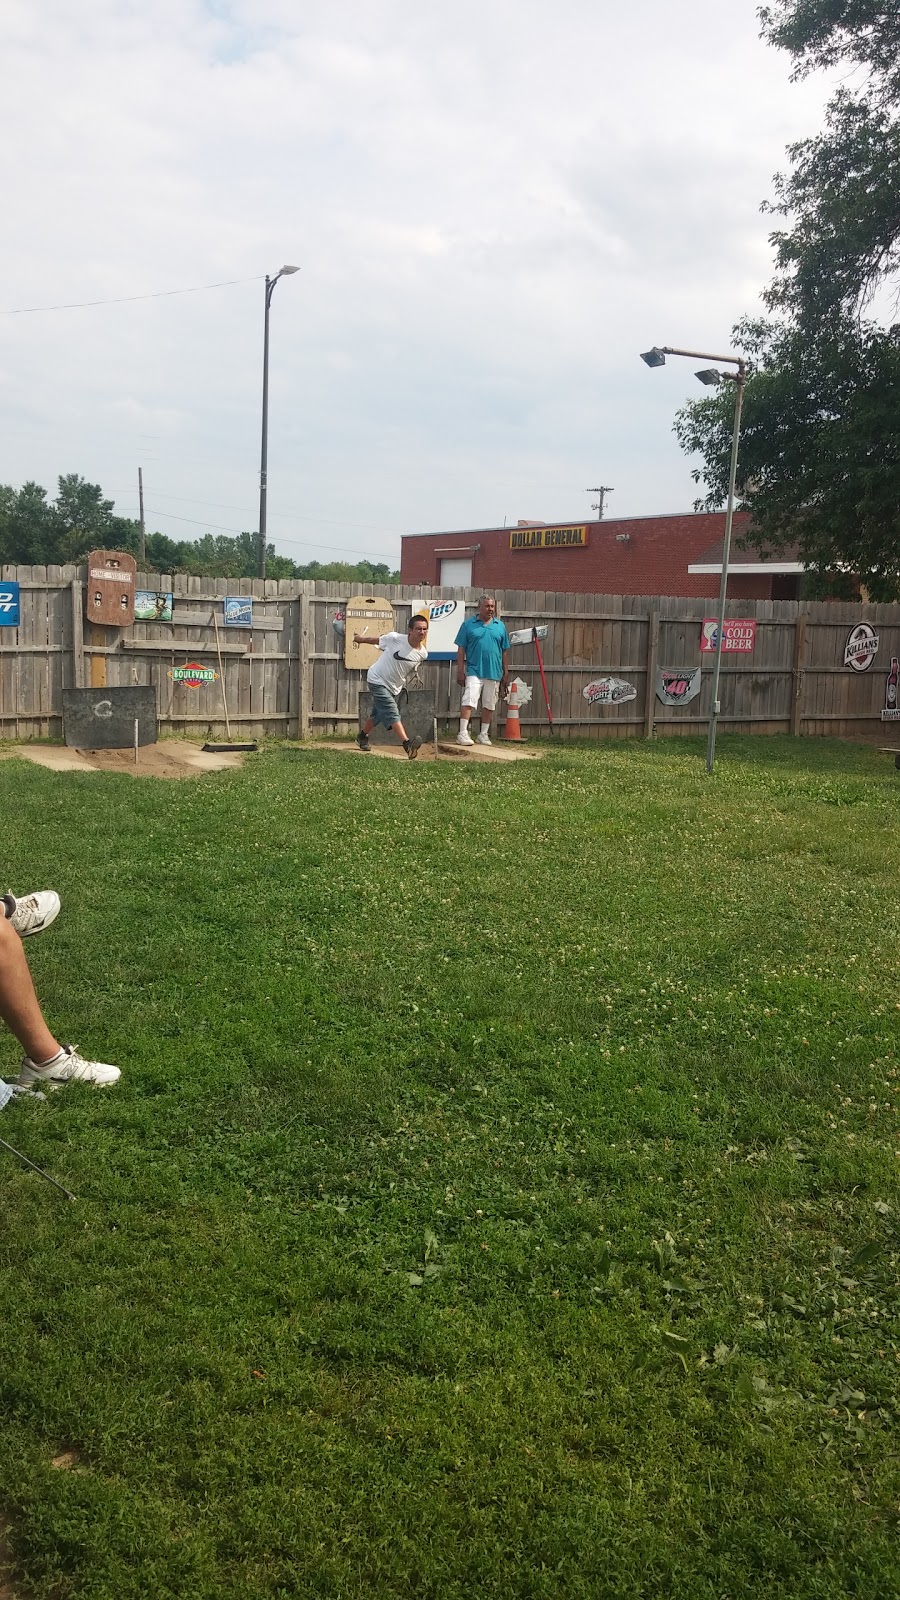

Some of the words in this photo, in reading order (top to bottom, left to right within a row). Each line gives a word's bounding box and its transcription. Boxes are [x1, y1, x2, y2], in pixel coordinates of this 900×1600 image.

[512, 531, 542, 547] DOLLAR
[545, 528, 583, 545] GENERAL
[726, 628, 753, 639] COLD
[725, 639, 752, 649] BEER
[174, 670, 213, 680] BOULEVARD
[666, 681, 687, 695] 40
